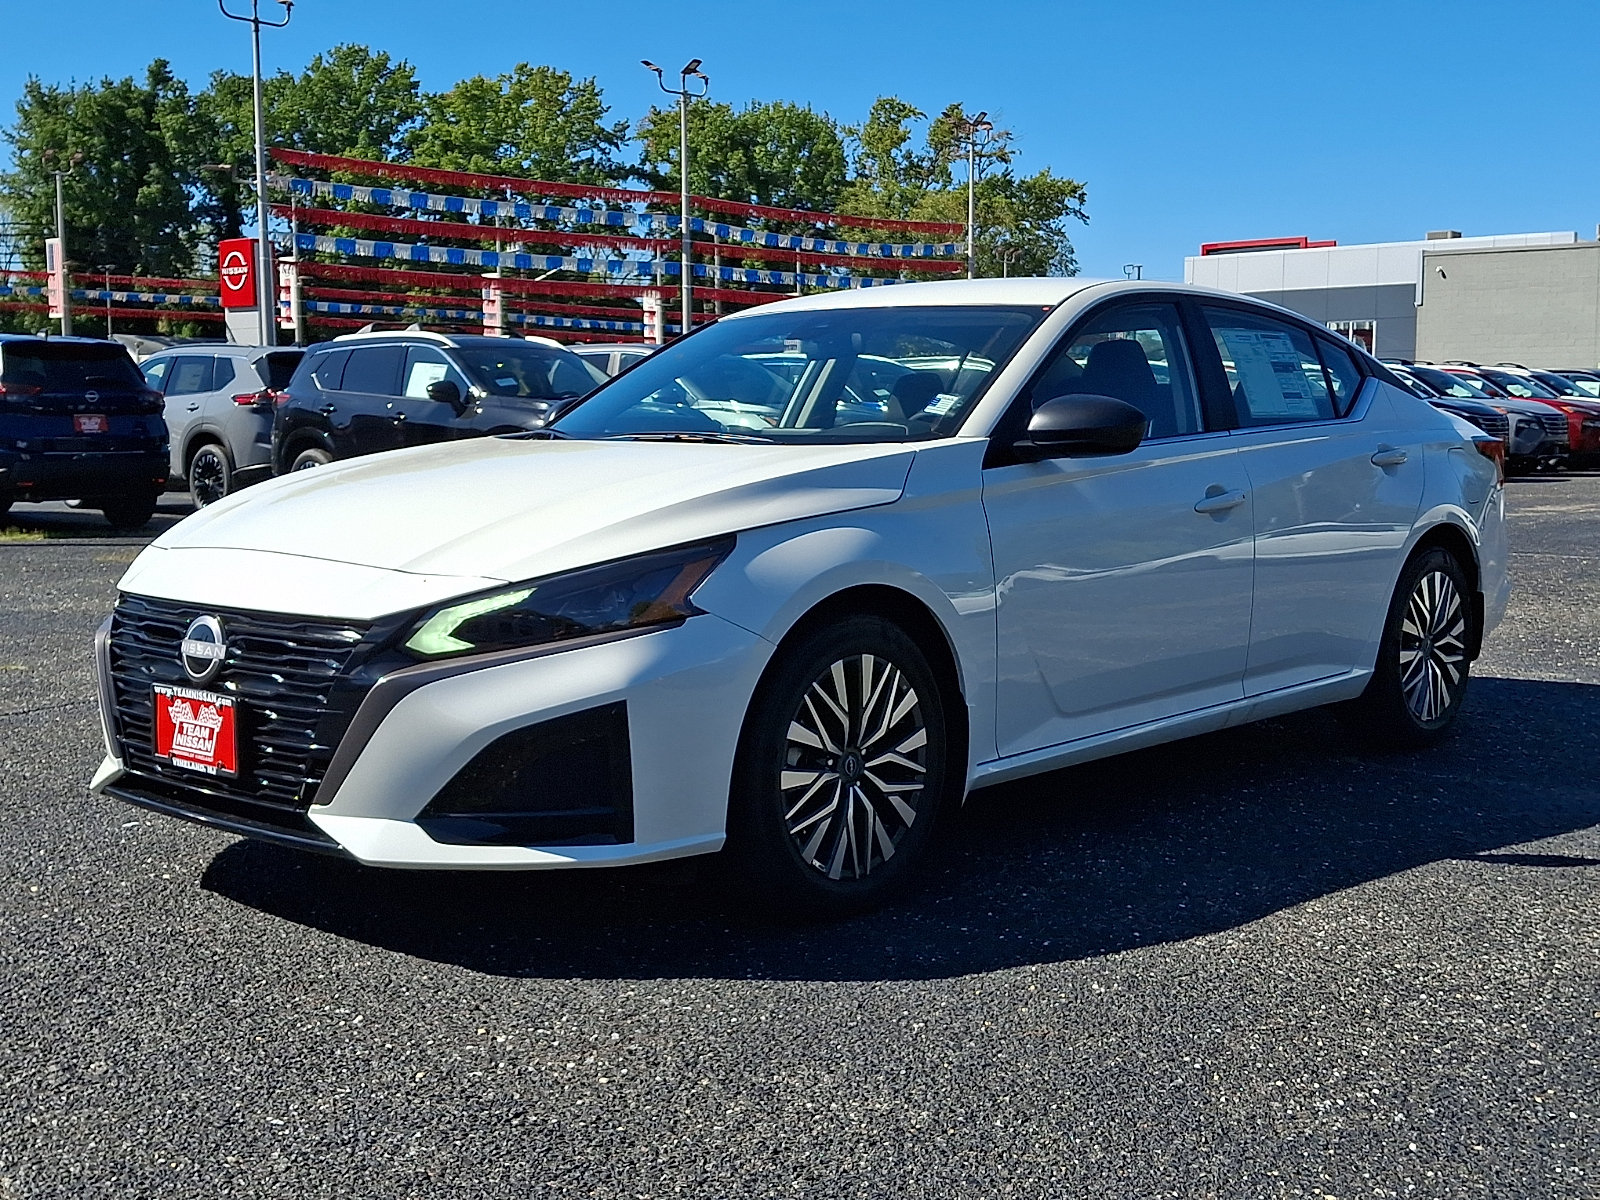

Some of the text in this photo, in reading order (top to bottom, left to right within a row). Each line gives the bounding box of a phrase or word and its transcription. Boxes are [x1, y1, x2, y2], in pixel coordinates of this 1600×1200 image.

[221, 266, 248, 275] NISSAN
[182, 642, 225, 658] NISSAN
[182, 723, 210, 738] TEAM
[176, 734, 213, 752] NISSAN
